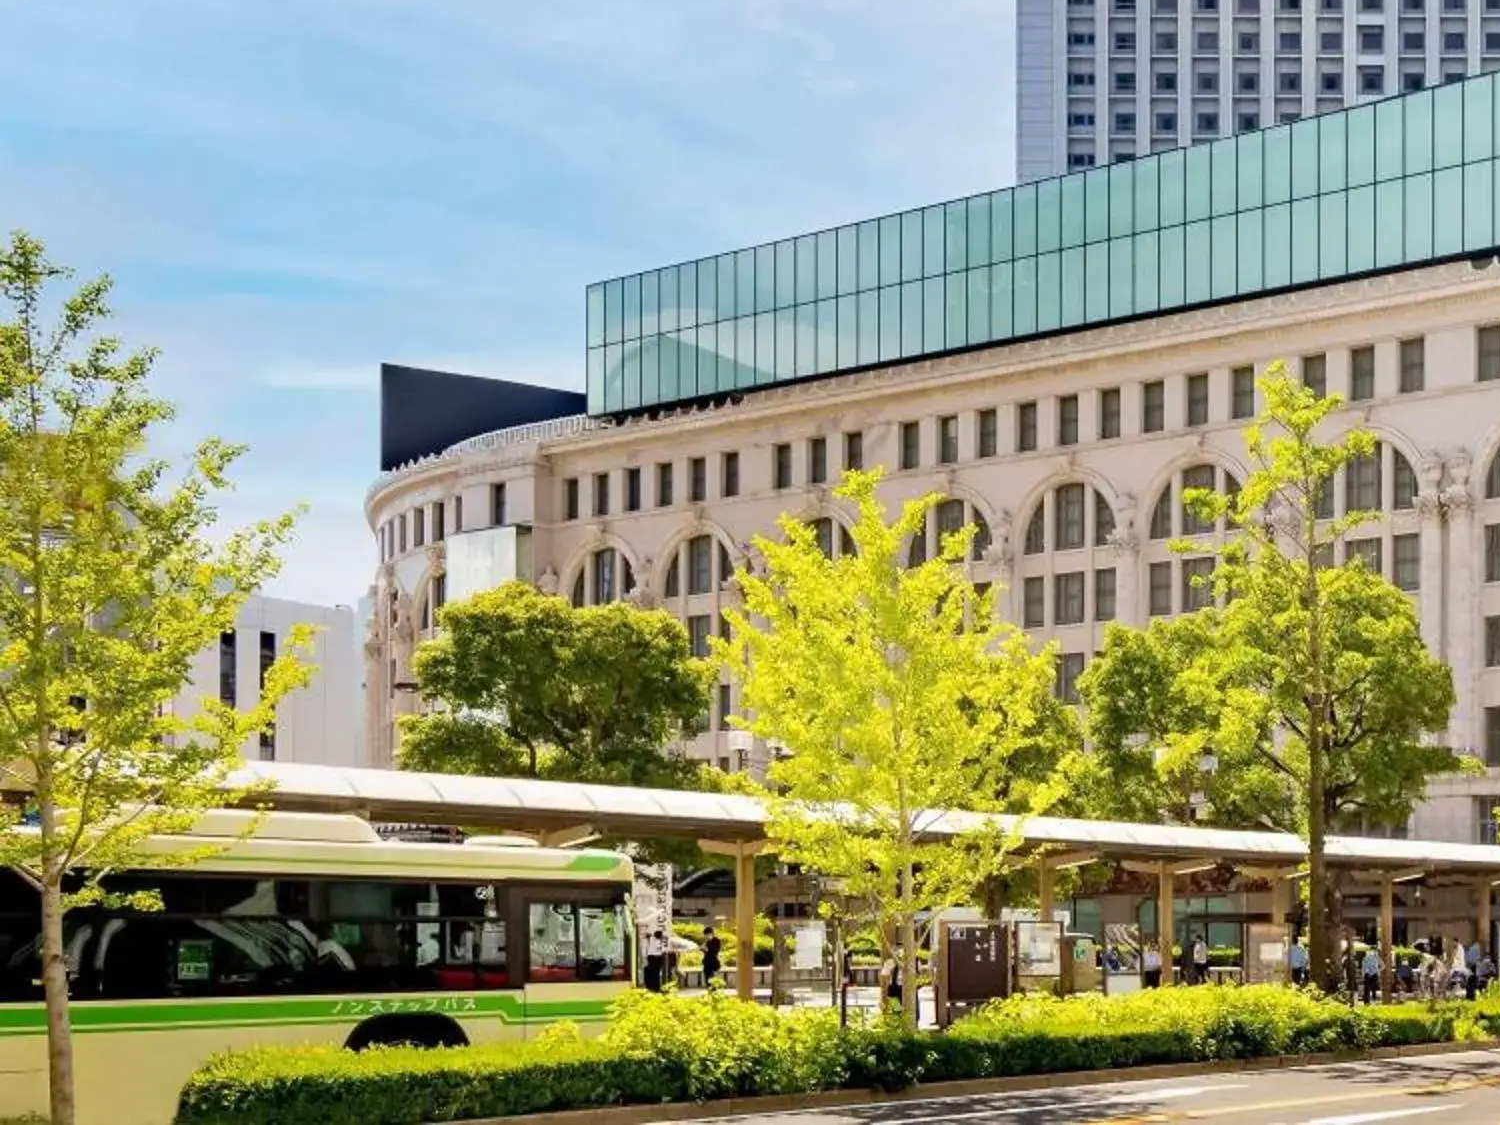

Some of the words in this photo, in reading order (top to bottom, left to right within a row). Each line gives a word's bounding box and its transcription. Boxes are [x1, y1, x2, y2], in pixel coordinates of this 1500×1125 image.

[330, 995, 477, 1014] ノンステップバス
